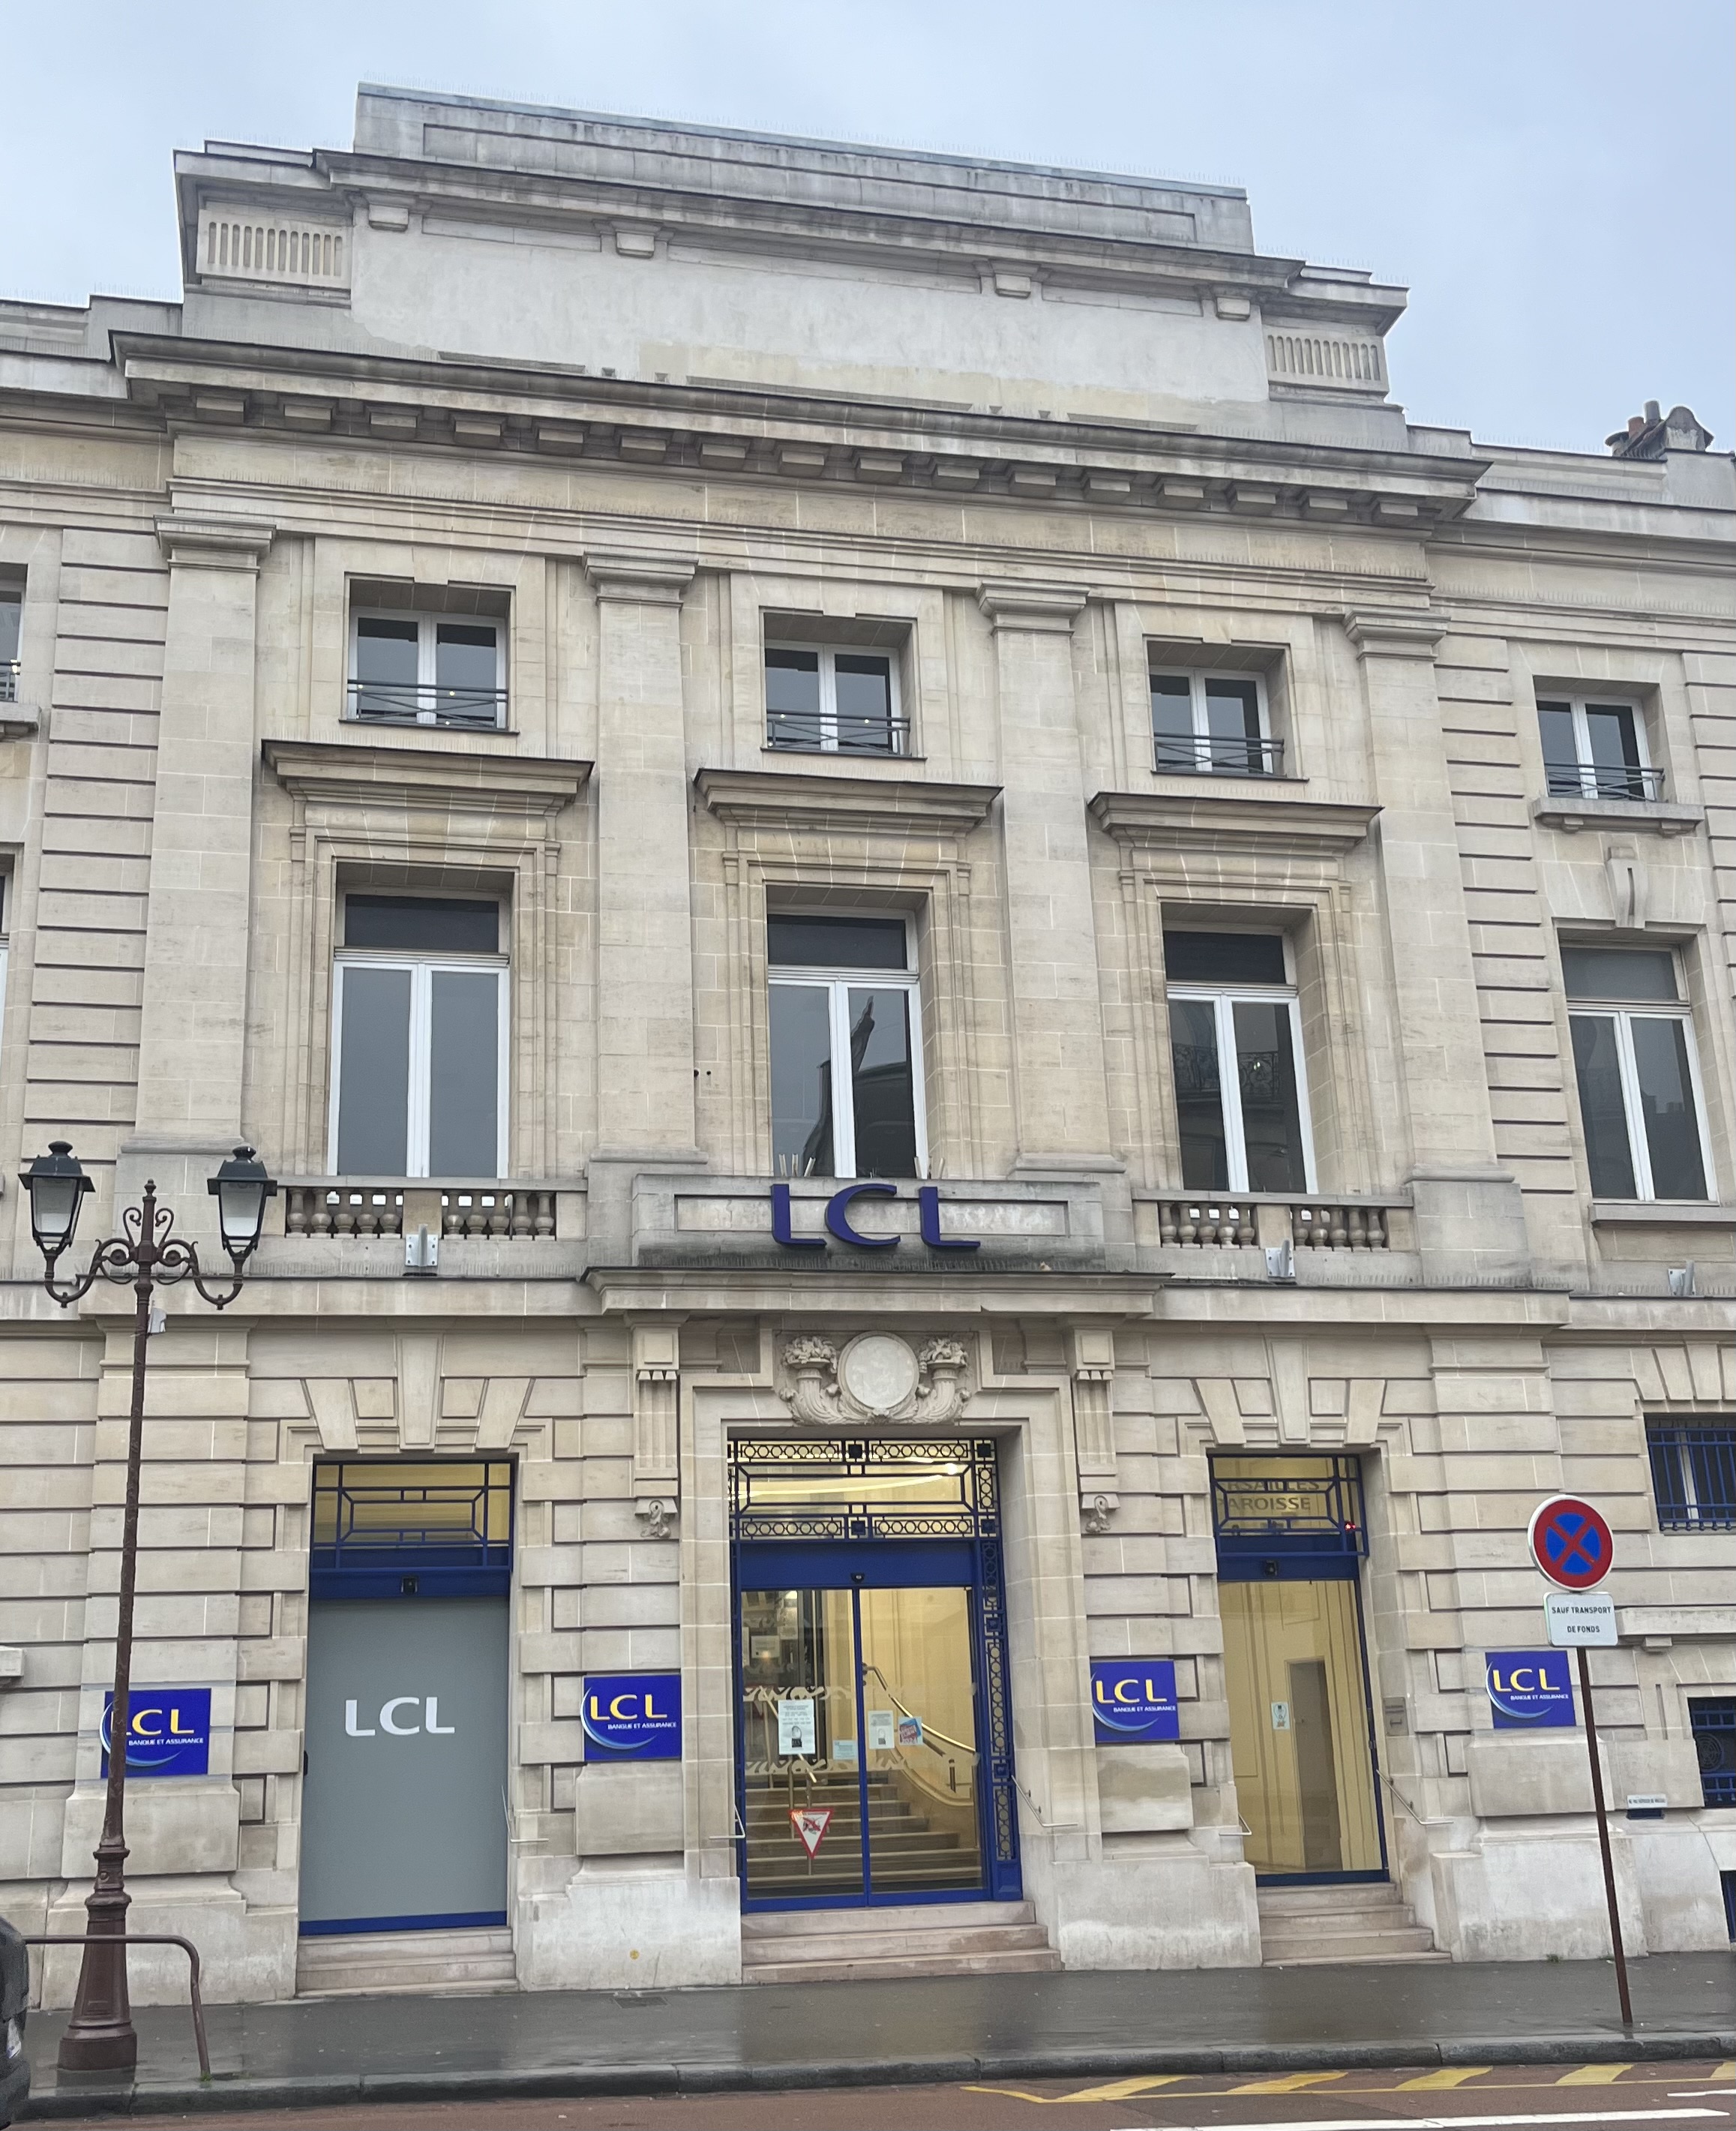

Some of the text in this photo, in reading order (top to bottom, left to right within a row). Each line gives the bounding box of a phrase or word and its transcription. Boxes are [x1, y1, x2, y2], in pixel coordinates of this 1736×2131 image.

[770, 1183, 981, 1248] LCL
[1221, 1481, 1320, 1491] RSAILLES
[1552, 1606, 1611, 1614] SAUF TRANSPORT
[1096, 1679, 1167, 1703] LCL
[1492, 1668, 1560, 1692] LCL
[345, 1696, 455, 1736] LCL
[590, 1694, 667, 1720] LCL
[111, 1709, 194, 1736] CL
